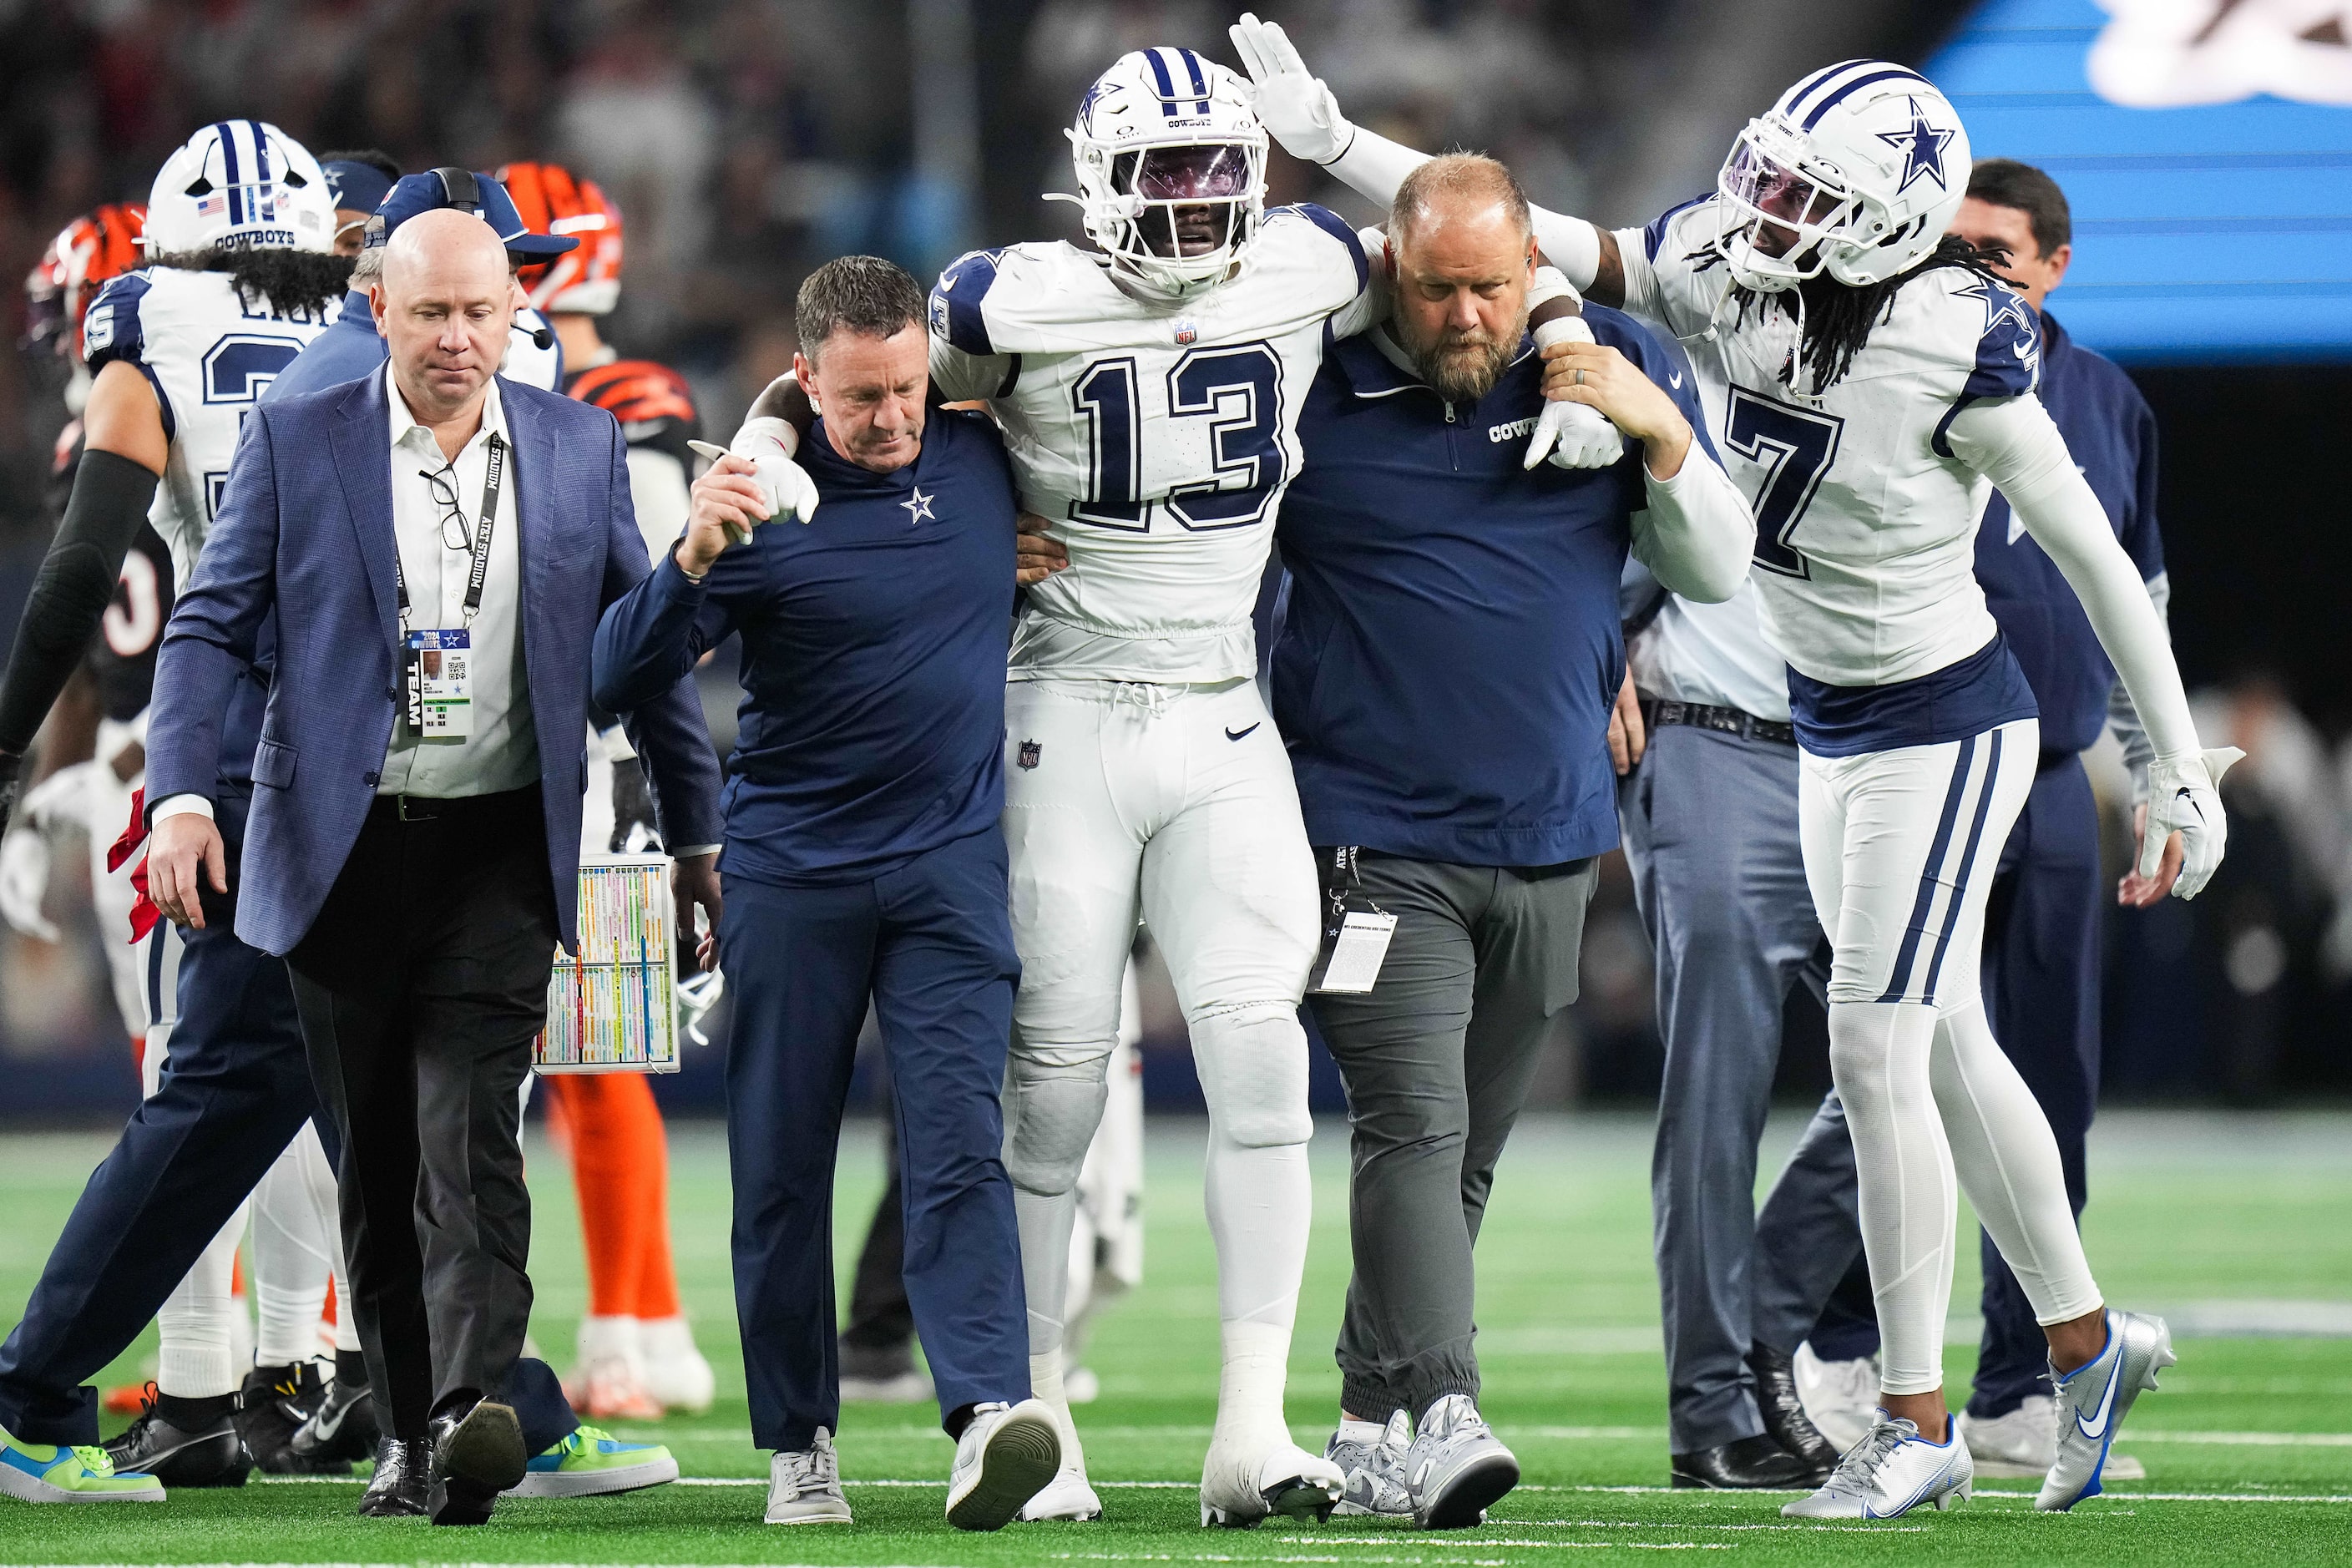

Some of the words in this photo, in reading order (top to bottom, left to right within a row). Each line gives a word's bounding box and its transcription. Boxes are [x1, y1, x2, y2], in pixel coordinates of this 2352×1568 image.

[215, 230, 295, 250] COWBOYS
[1177, 332, 1196, 344] NFL
[1068, 339, 1288, 533] 13
[487, 447, 502, 490] STADIUM
[1725, 382, 1845, 581] 7
[478, 515, 493, 544] AT&T
[470, 542, 489, 589] STADIUM
[407, 661, 421, 725] TEAM
[1020, 751, 1039, 766] NFL
